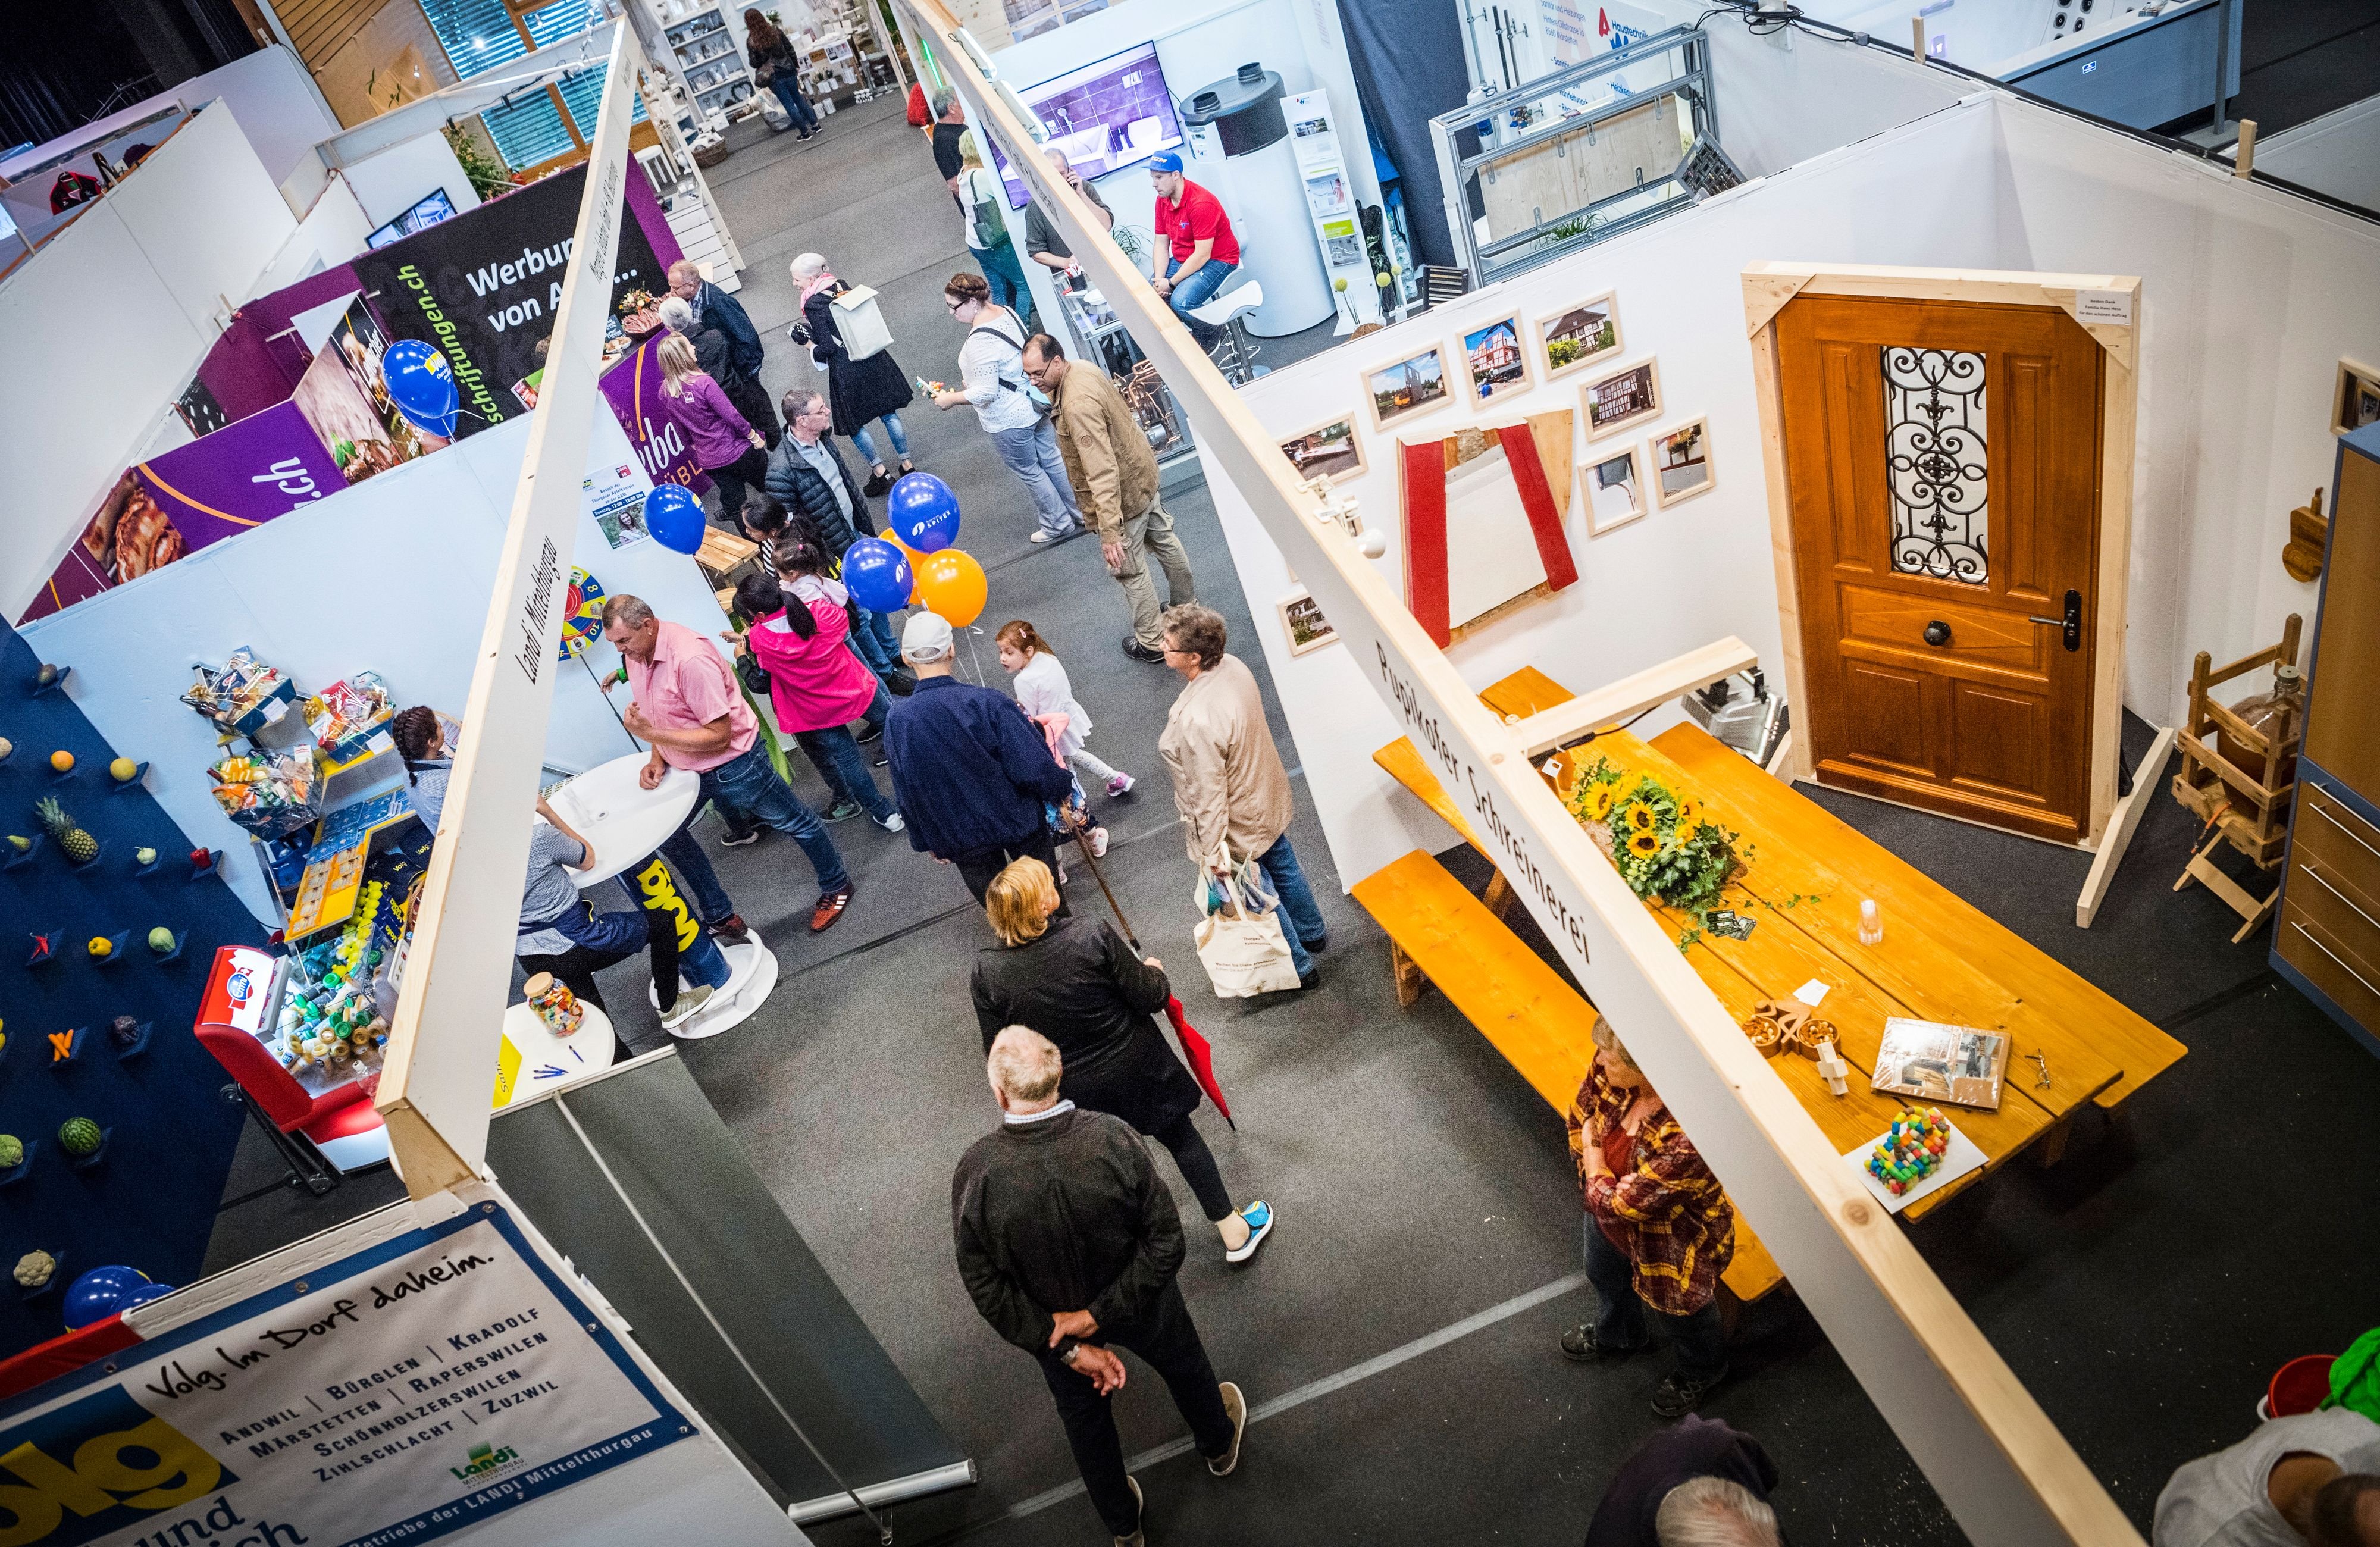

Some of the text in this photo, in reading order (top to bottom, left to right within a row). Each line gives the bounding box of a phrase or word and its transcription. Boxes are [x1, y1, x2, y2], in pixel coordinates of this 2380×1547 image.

[466, 237, 575, 297] Werbun
[488, 298, 542, 333] von
[397, 264, 504, 426] schriftungen.ch
[591, 493, 611, 504] Thurgauer
[600, 486, 614, 494] Besuch
[926, 510, 951, 528] SPITEX
[587, 584, 599, 593] 8
[589, 622, 600, 636] 10
[515, 619, 541, 685] Landi
[1376, 639, 1591, 966] Pupikofer Schreinerei
[393, 861, 408, 872] Volg
[416, 844, 430, 856] Volg
[146, 1252, 495, 1399] Volg. Im Dorf daheim.
[432, 1506, 461, 1523] der
[464, 1479, 522, 1510] LANDI
[524, 1429, 653, 1486] Mittelthurgau
[449, 1445, 519, 1480] Landi
